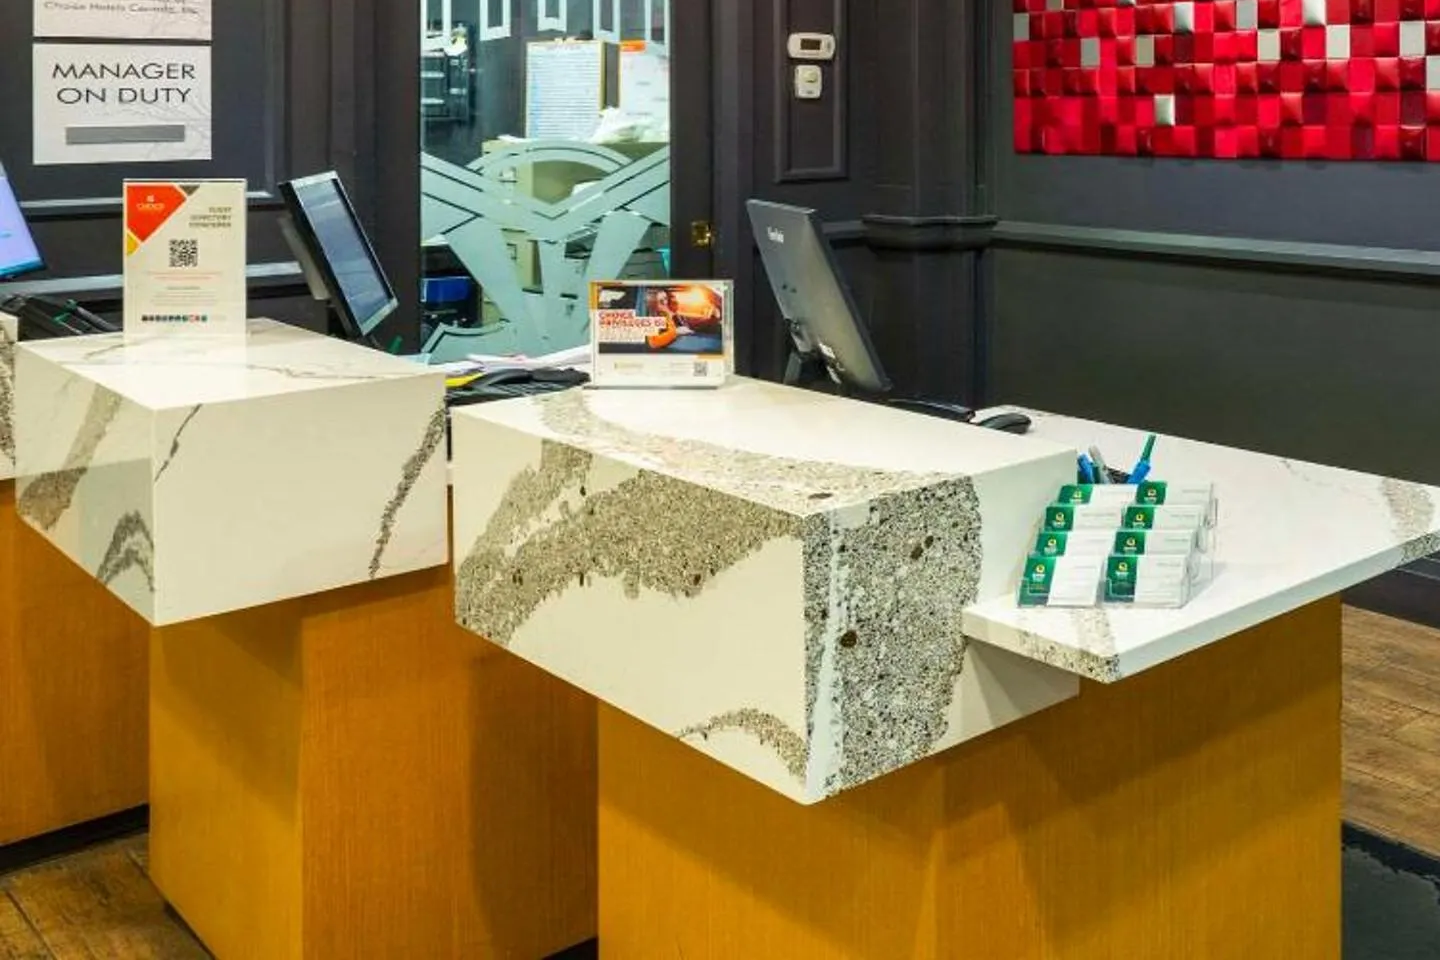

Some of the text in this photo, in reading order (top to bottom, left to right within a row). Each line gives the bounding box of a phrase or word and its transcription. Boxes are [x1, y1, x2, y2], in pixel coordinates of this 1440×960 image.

[52, 62, 197, 81] MANAGER
[57, 87, 192, 105] ON DUTY
